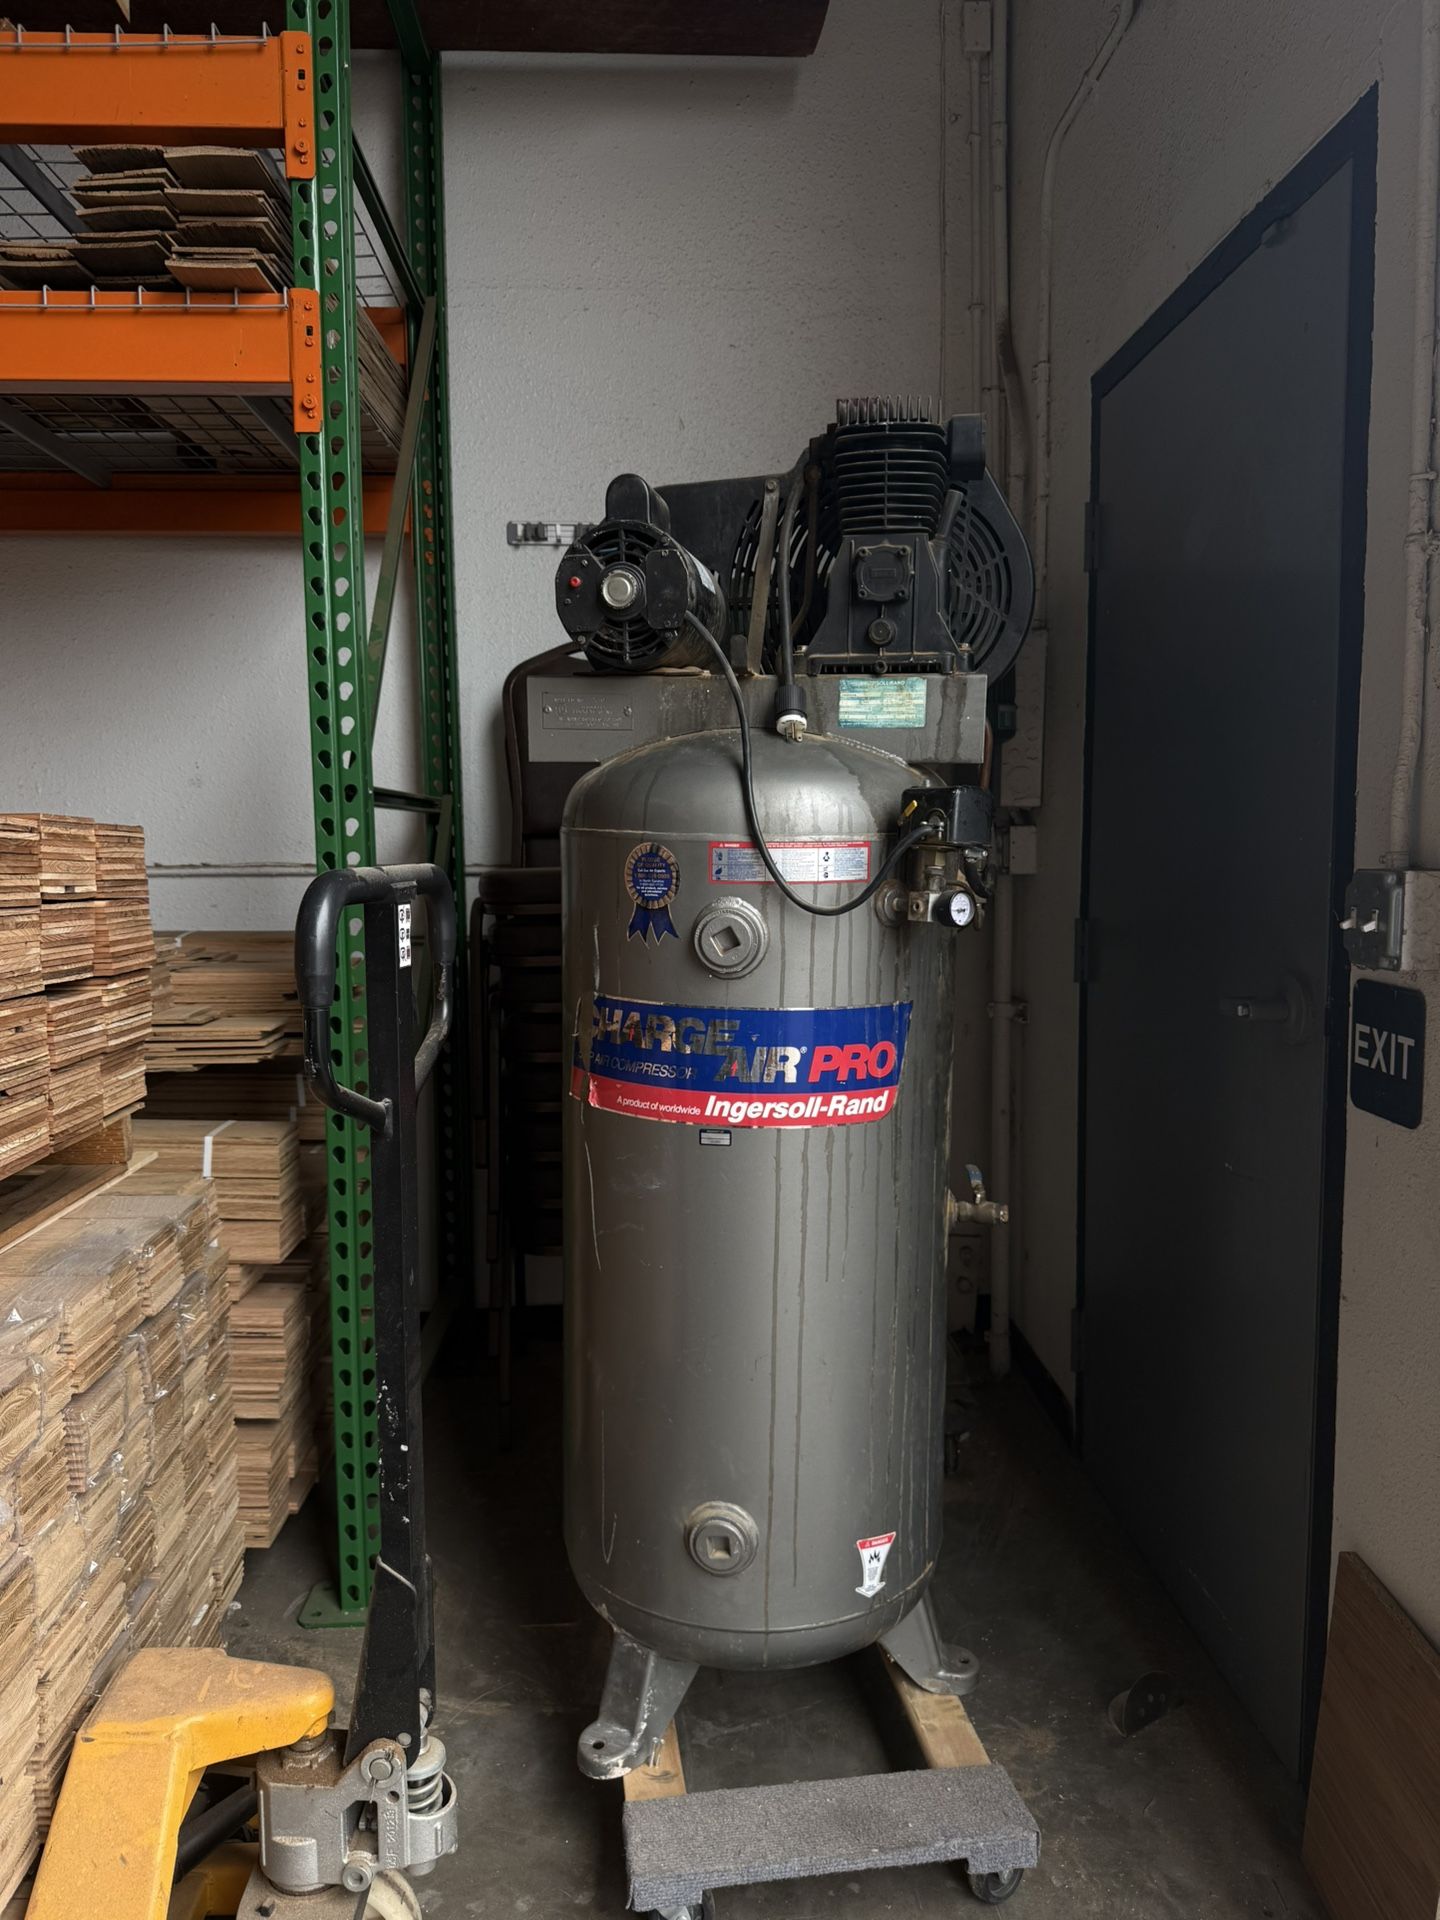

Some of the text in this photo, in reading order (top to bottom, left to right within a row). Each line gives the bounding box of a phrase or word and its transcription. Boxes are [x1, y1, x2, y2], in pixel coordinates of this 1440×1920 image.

[713, 1041, 897, 1084] AIR PRO
[1354, 1023, 1415, 1080] EXIT
[616, 1090, 889, 1124] A product of worldwide Ingersoll-Rand
